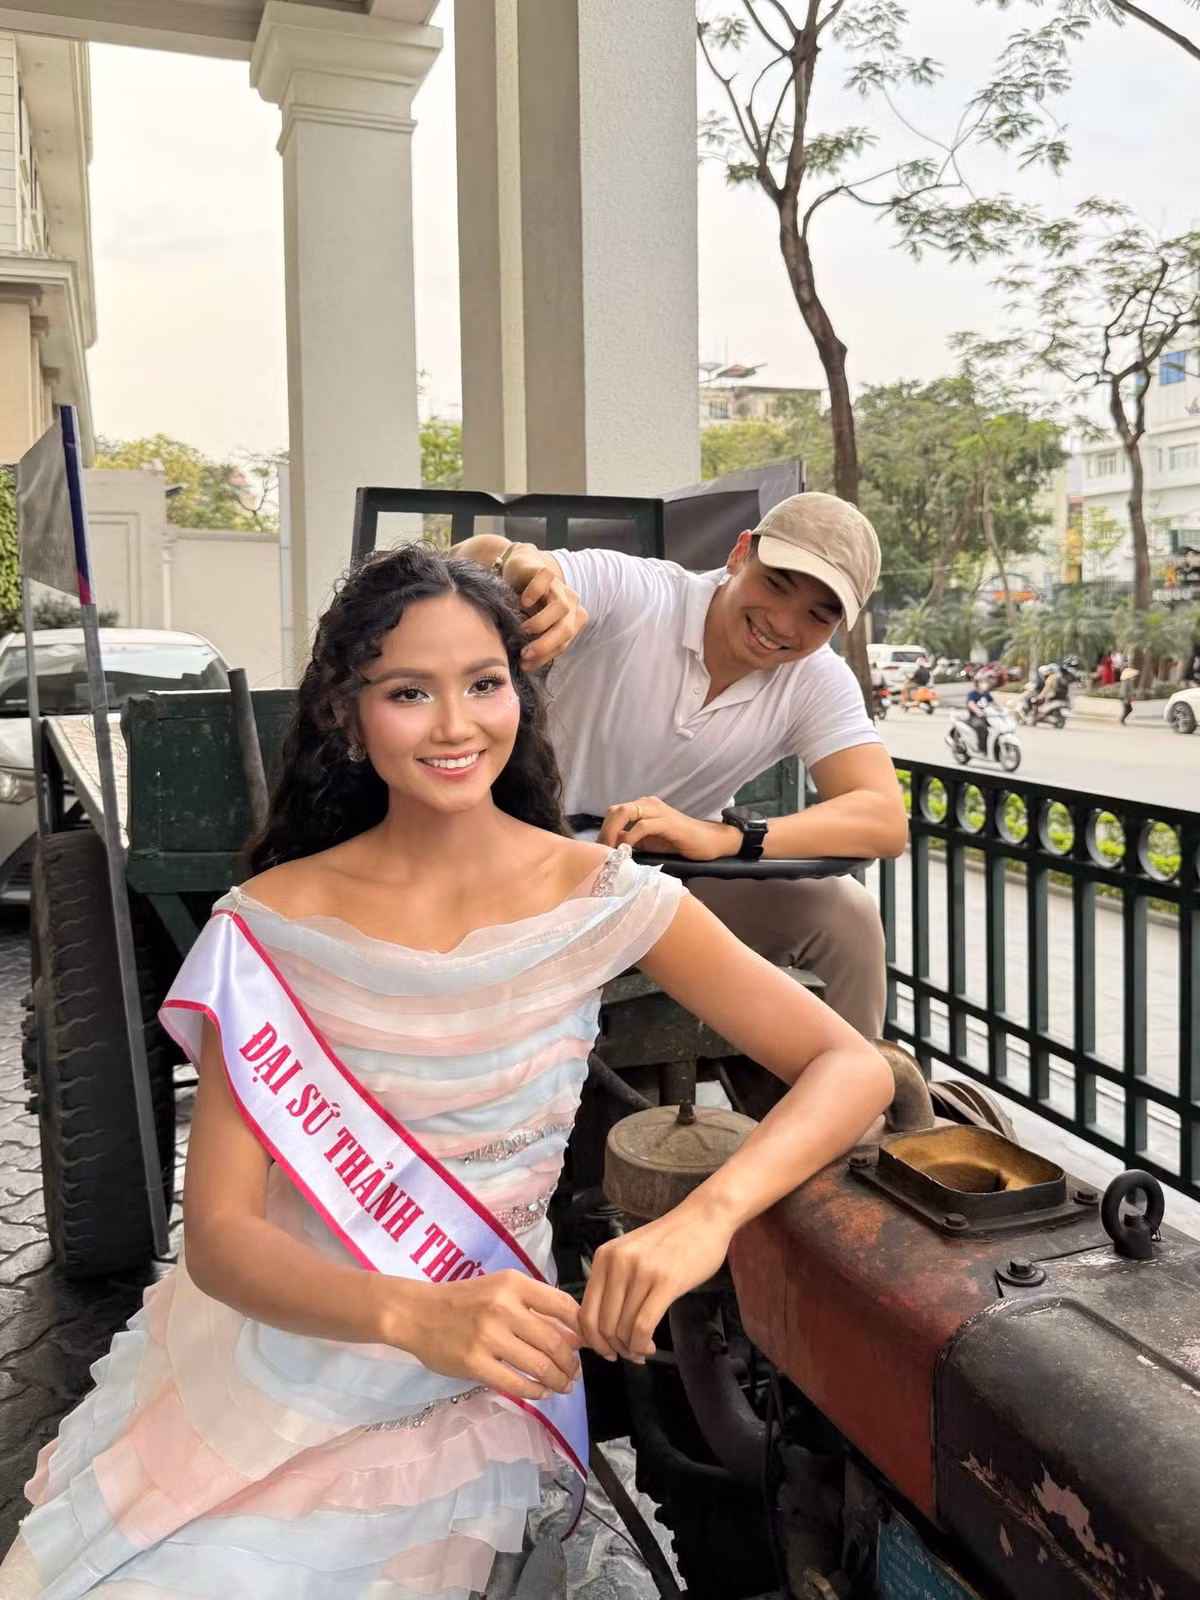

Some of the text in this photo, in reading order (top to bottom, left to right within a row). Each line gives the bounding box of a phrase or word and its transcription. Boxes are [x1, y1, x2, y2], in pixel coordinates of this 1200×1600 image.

[239, 1021, 486, 1283] ĐẠI SỨ THẢNH THƠ
